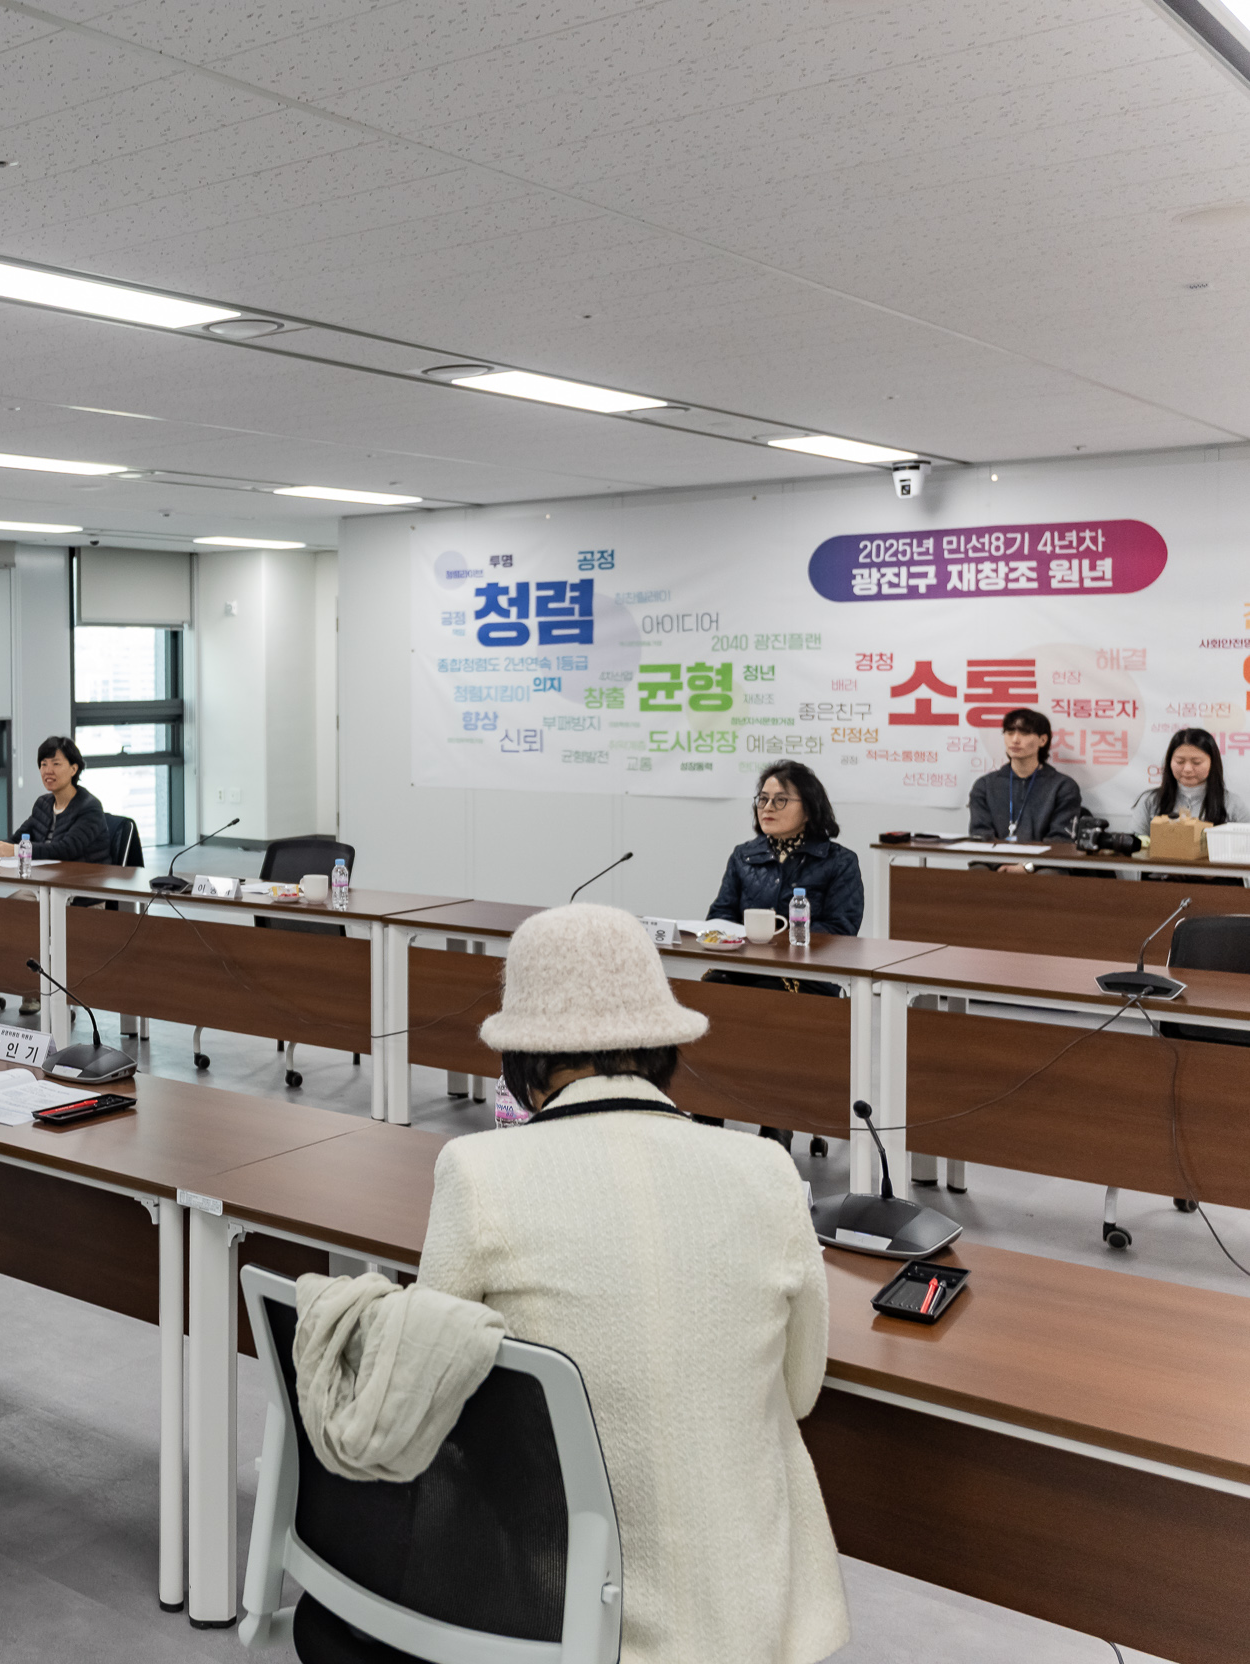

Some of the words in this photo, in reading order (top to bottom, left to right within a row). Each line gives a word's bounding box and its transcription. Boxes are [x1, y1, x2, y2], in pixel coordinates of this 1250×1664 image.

[859, 538, 934, 563] 2025년
[943, 532, 1030, 559] 민선8기
[1037, 529, 1106, 555] 4년차
[489, 554, 513, 568] 투명
[577, 549, 615, 571] 공정
[851, 565, 937, 595] 광진구
[947, 561, 1038, 591] 재창조
[1049, 558, 1113, 588] 원년
[474, 578, 594, 647] 청렴
[641, 612, 719, 635] 아이디어
[711, 634, 748, 652] 2040
[754, 633, 822, 651] 광진플랜
[437, 657, 500, 673] 종합청렴도
[504, 656, 552, 672] 2년연속
[556, 655, 589, 671] 1등급
[855, 652, 893, 671] 경청
[1096, 648, 1147, 671] 해결
[743, 664, 775, 682] 청년
[1051, 670, 1081, 685] 현장
[453, 684, 530, 703] 청렴지킴이
[532, 676, 562, 693] 의지
[638, 661, 733, 712] 균형
[831, 679, 857, 691] 배려
[888, 658, 1038, 728] 소통
[584, 686, 625, 709] 창출
[798, 702, 872, 722] 좋은친구
[1051, 698, 1139, 719] 직통문자
[1165, 702, 1231, 718] 식품안전
[462, 710, 499, 732] 향상
[542, 715, 601, 732] 부패방지
[499, 728, 545, 753] 신뢰
[648, 730, 739, 754] 도시성장
[746, 734, 824, 755] 예술문화
[830, 727, 879, 743] 진정성
[946, 736, 978, 752] 공감
[1051, 728, 1129, 766] 친절
[903, 773, 957, 788] 선진행정
